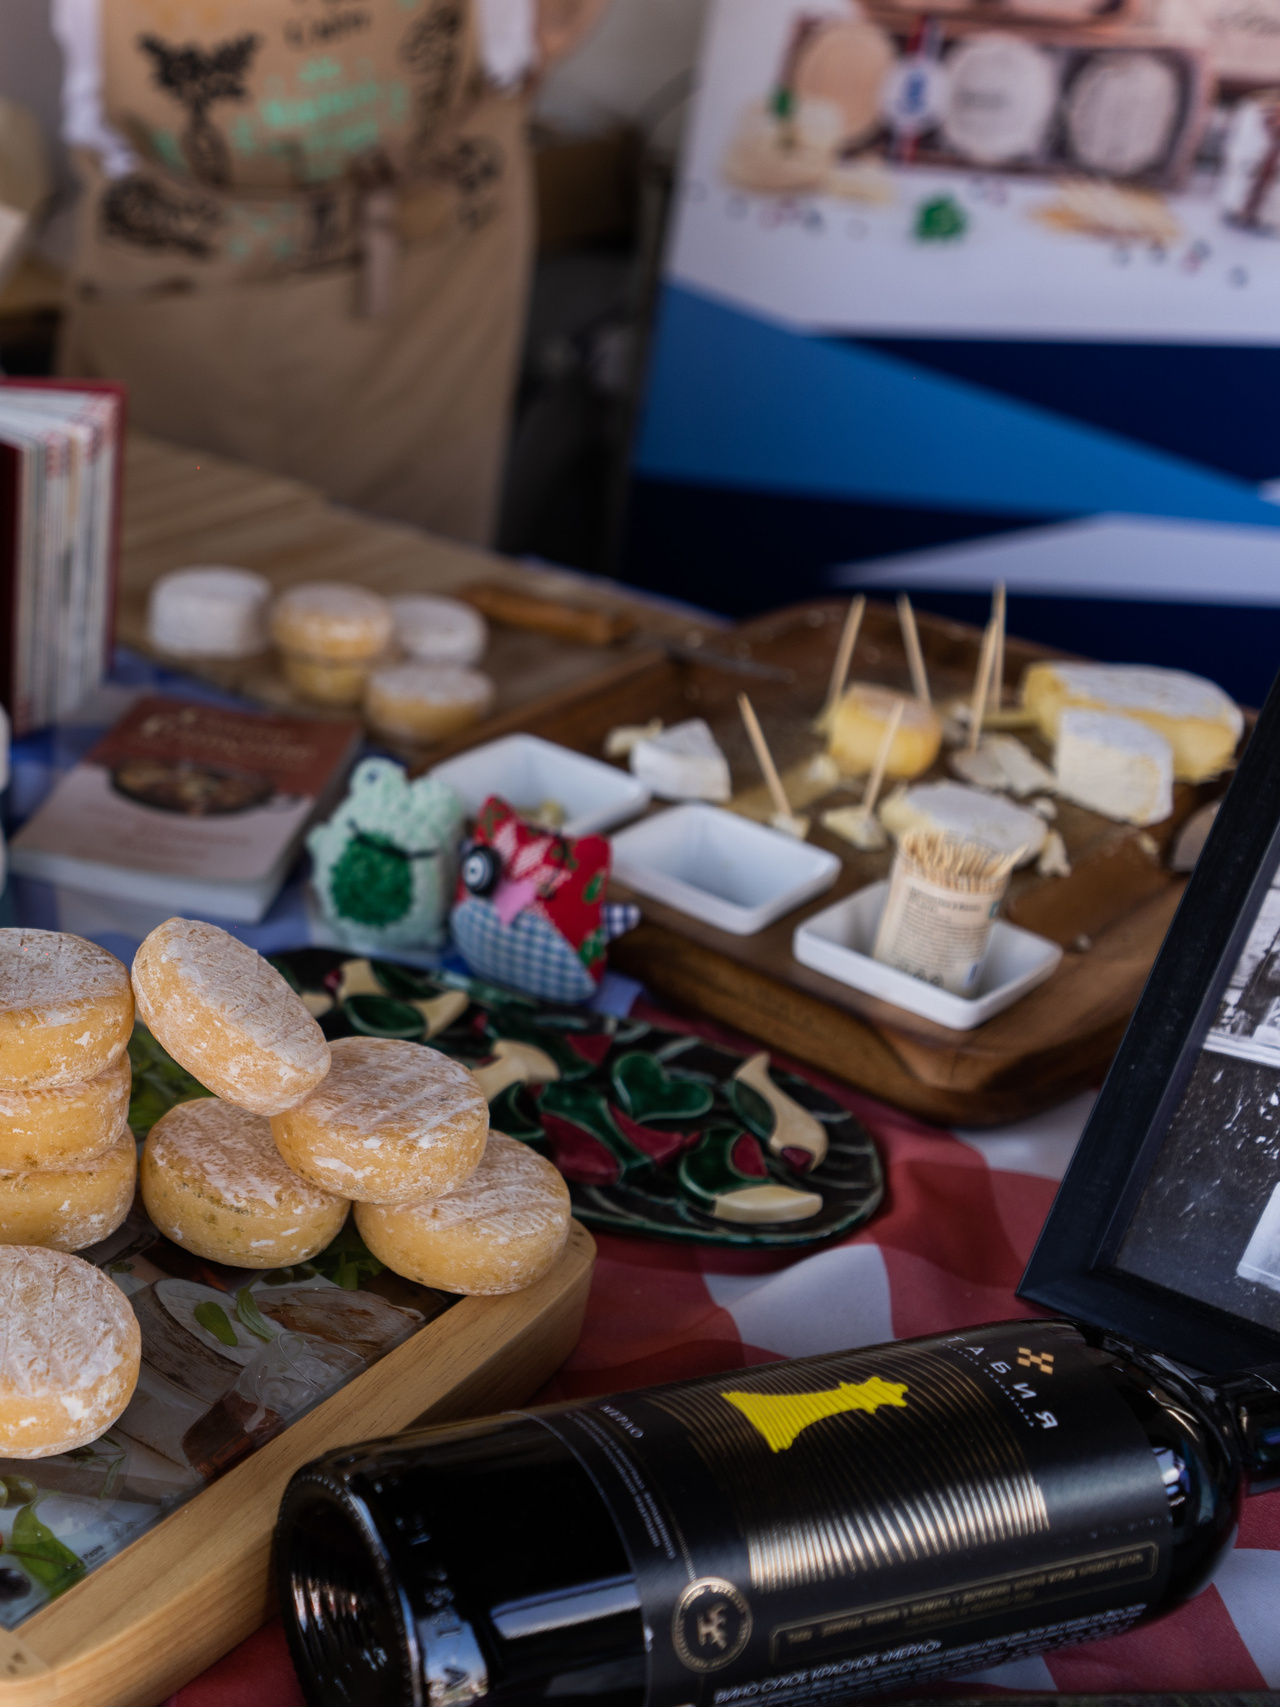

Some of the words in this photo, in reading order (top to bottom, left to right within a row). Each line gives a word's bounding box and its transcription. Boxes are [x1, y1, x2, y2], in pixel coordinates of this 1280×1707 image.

[946, 1335, 1059, 1429] ТАБИЯ
[714, 1681, 760, 1705] ВИНО
[761, 1668, 810, 1693] СУХОЕ
[811, 1652, 881, 1681] КРАСНОЕ
[881, 1639, 942, 1663] «МЕРЛО»
